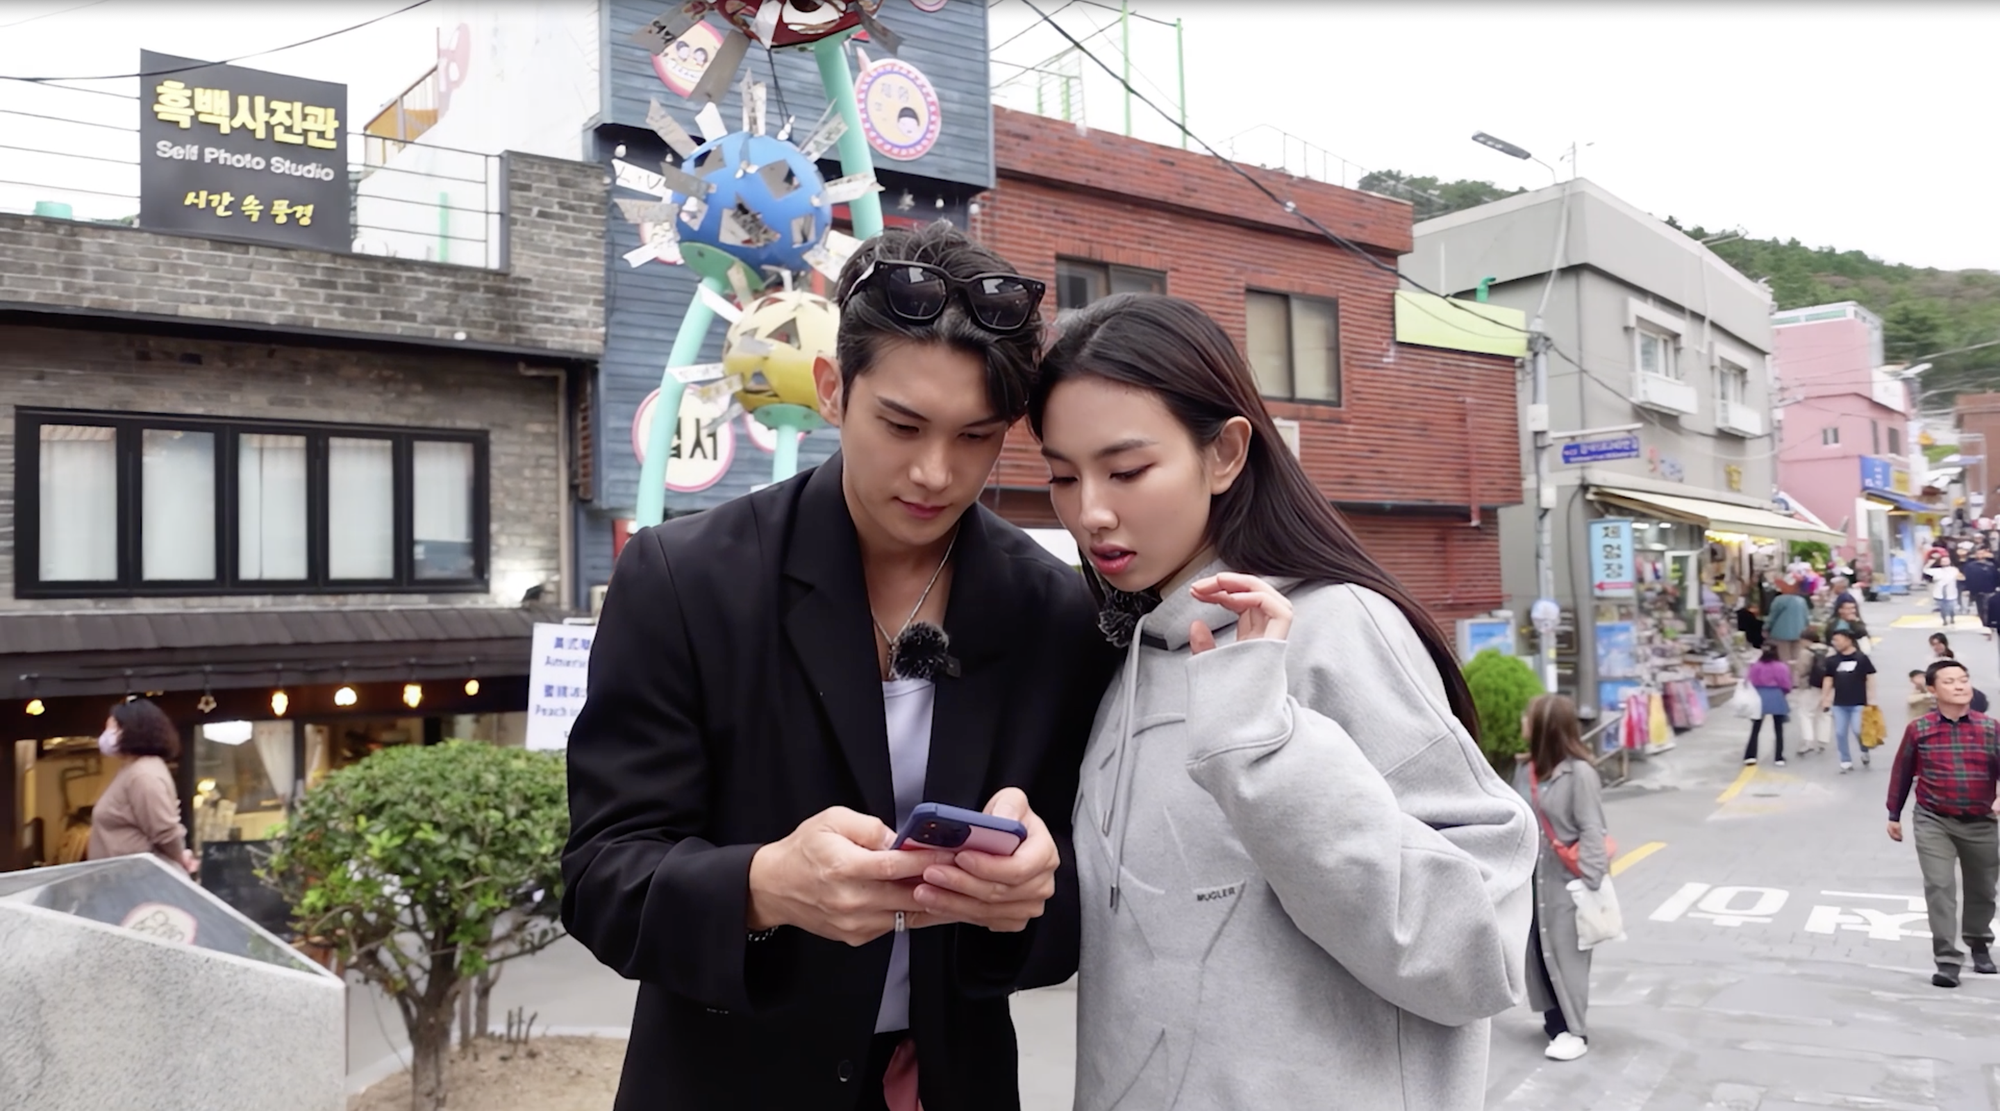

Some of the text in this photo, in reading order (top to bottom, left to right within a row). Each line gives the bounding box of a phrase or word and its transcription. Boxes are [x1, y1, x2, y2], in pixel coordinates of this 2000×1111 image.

[153, 80, 340, 150] 흑백사진관
[156, 140, 335, 182] Self Photo Studio
[184, 190, 315, 226] 시간 속 풍경
